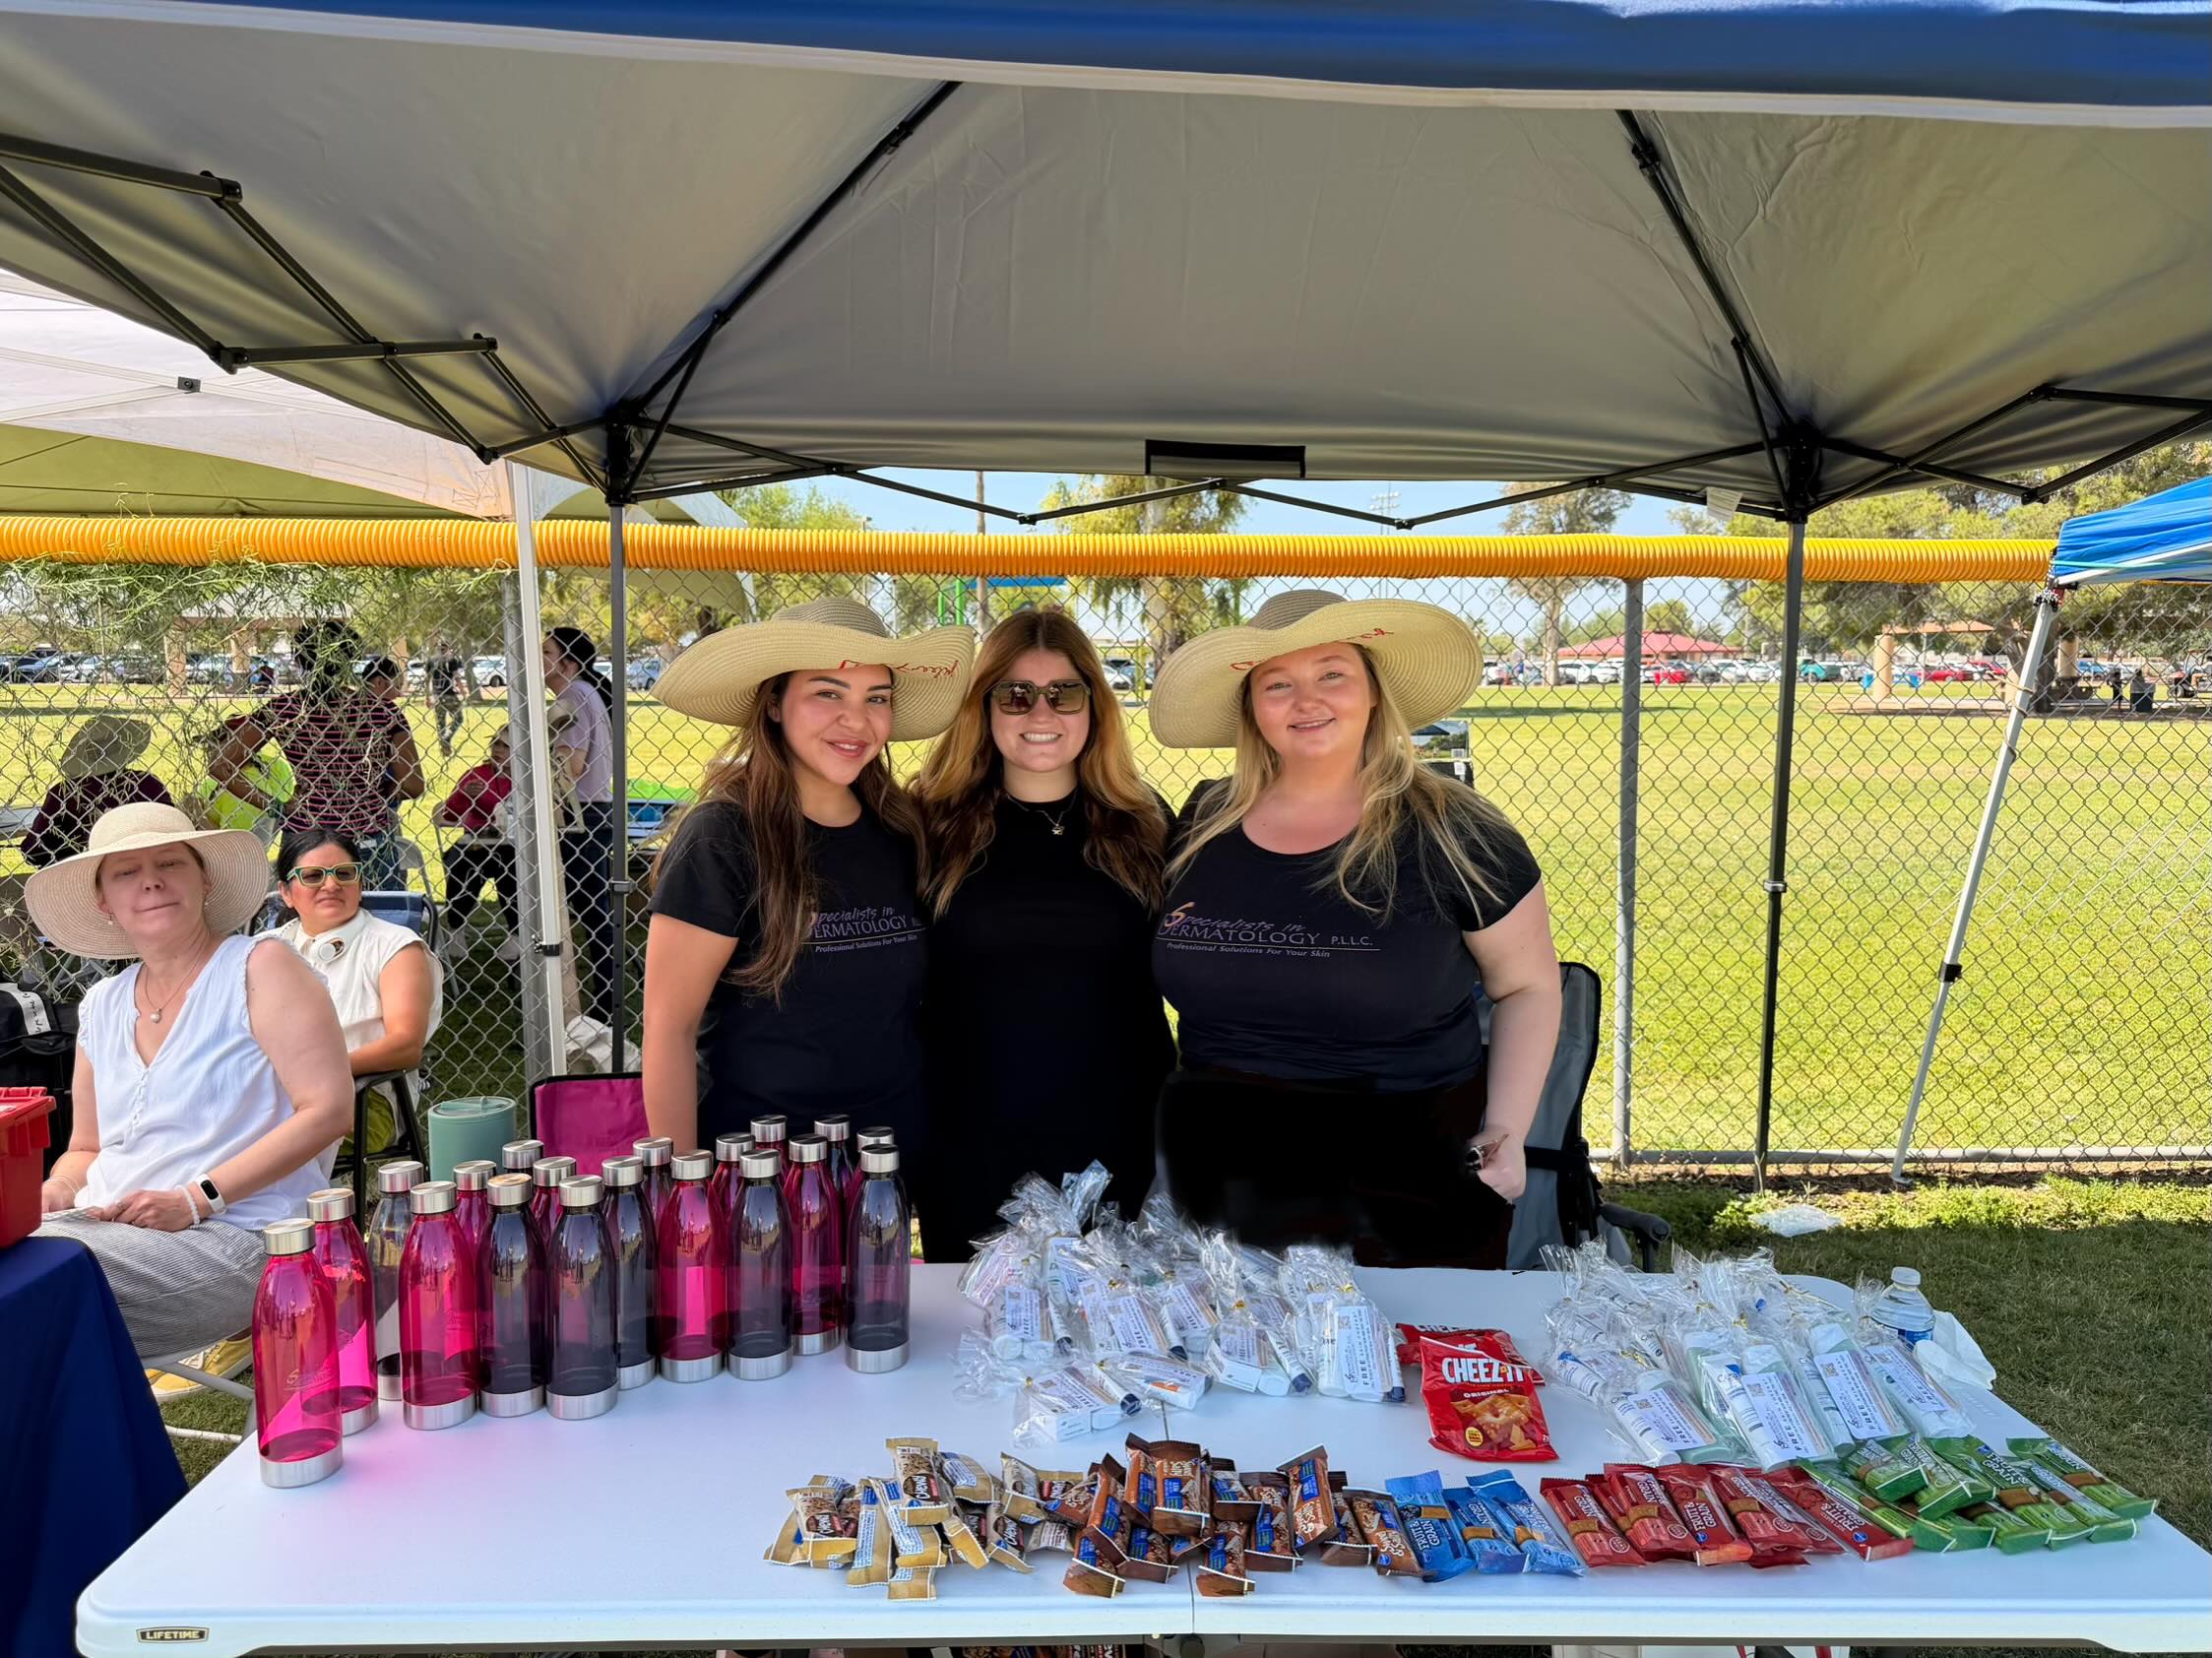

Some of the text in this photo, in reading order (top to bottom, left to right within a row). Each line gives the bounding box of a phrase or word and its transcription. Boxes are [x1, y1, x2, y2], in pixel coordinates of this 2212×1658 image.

[883, 906, 894, 916] in
[1164, 902, 1306, 932] Specialists in
[814, 915, 907, 938] ERMATOLOGY
[1158, 917, 1373, 946] DERMATOLOGY P.L.L.C.
[815, 943, 854, 953] Professional
[1166, 942, 1217, 952] Professional
[1220, 945, 1263, 954] Solutions
[1310, 949, 1331, 958] Skin
[1463, 1388, 1510, 1399] ORIGINAL
[912, 1475, 930, 1500] CHEWY
[1686, 1509, 1705, 1530] FRUIT
[1696, 1503, 1716, 1526] GRAIN
[1826, 1507, 1859, 1531] FRUIT
[1412, 1529, 1429, 1550] FRUIT
[1421, 1520, 1440, 1545] GRAIN
[146, 1630, 200, 1640] LIFETIME
